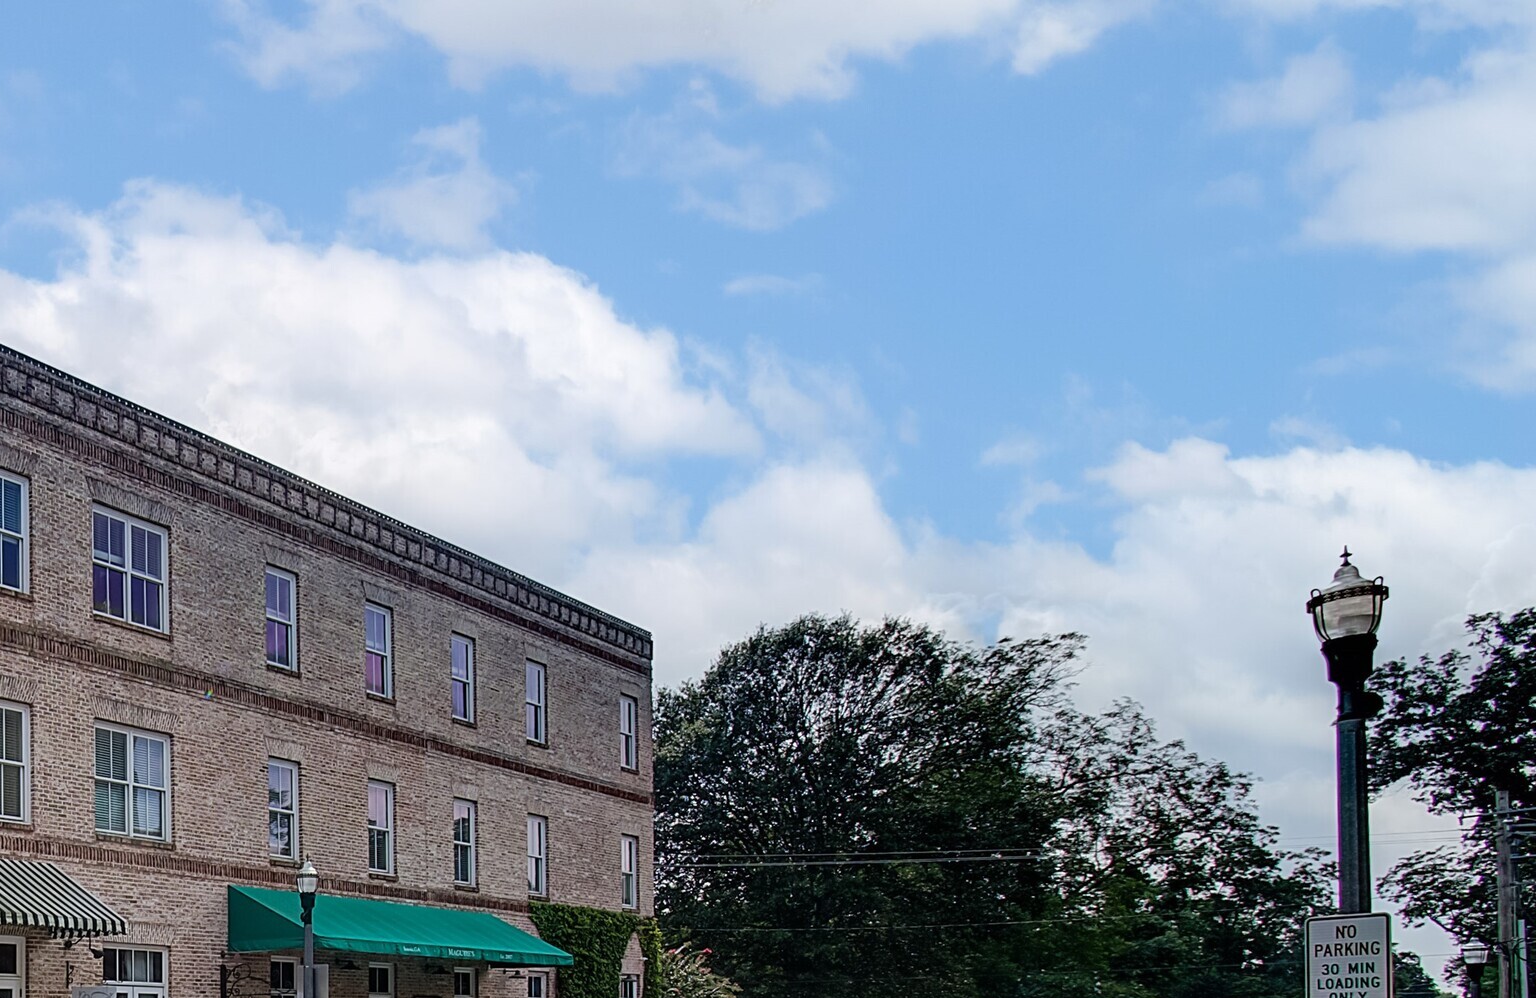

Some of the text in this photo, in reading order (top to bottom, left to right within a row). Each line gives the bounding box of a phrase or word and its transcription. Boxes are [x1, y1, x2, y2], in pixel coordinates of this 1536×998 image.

[1335, 924, 1357, 940] NO
[1314, 941, 1381, 958] PARKING
[1321, 961, 1375, 976] 30 MIN
[1317, 976, 1381, 990] LOADING
